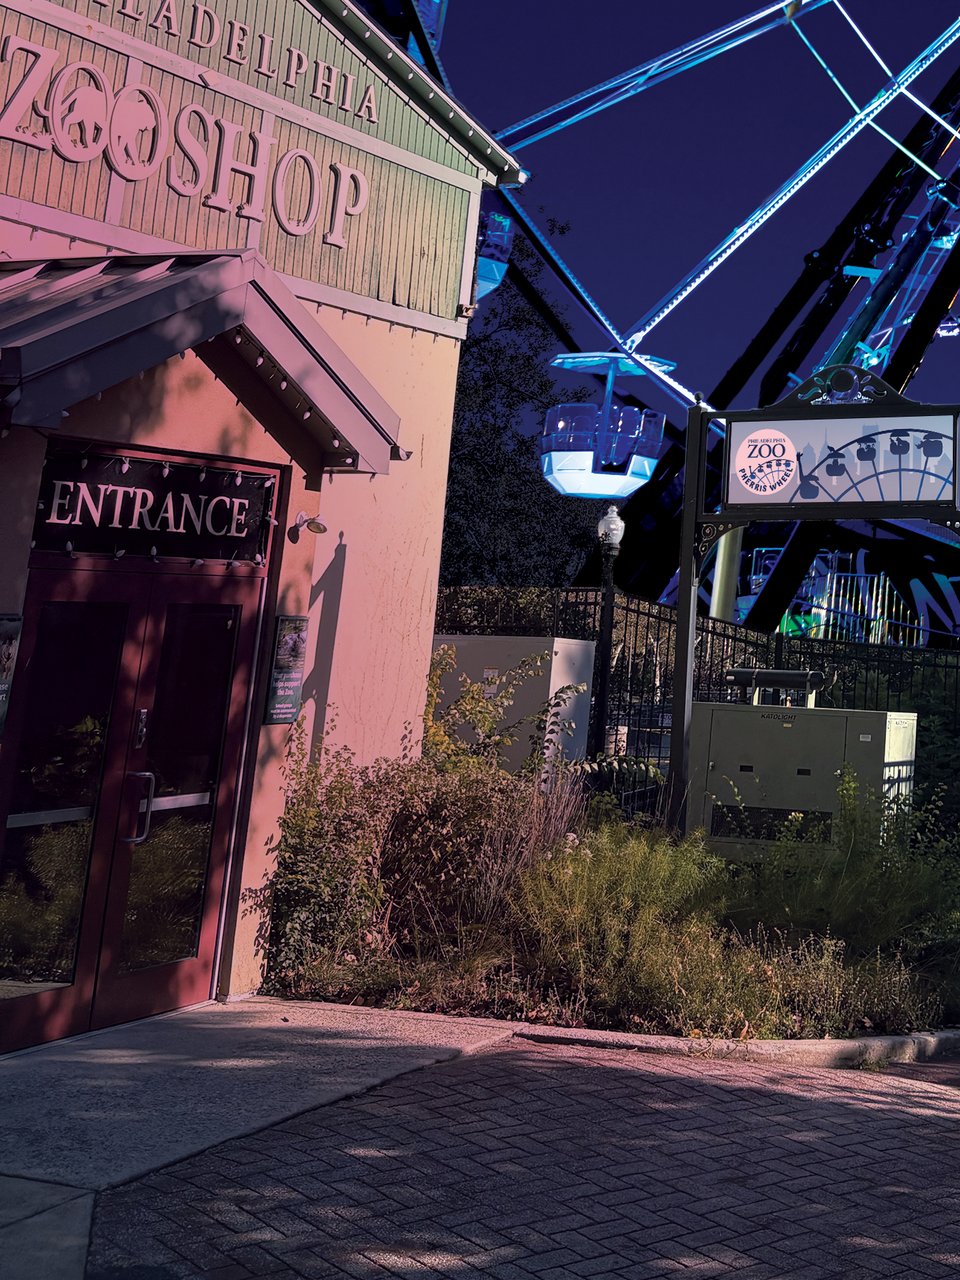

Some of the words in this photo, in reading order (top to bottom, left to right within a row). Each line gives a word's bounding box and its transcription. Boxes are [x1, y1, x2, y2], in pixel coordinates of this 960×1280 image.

[747, 443, 786, 458] ZOO
[738, 468, 768, 492] PHERRIS
[769, 468, 794, 491] WHEEL
[45, 480, 250, 538] ENTRANCE
